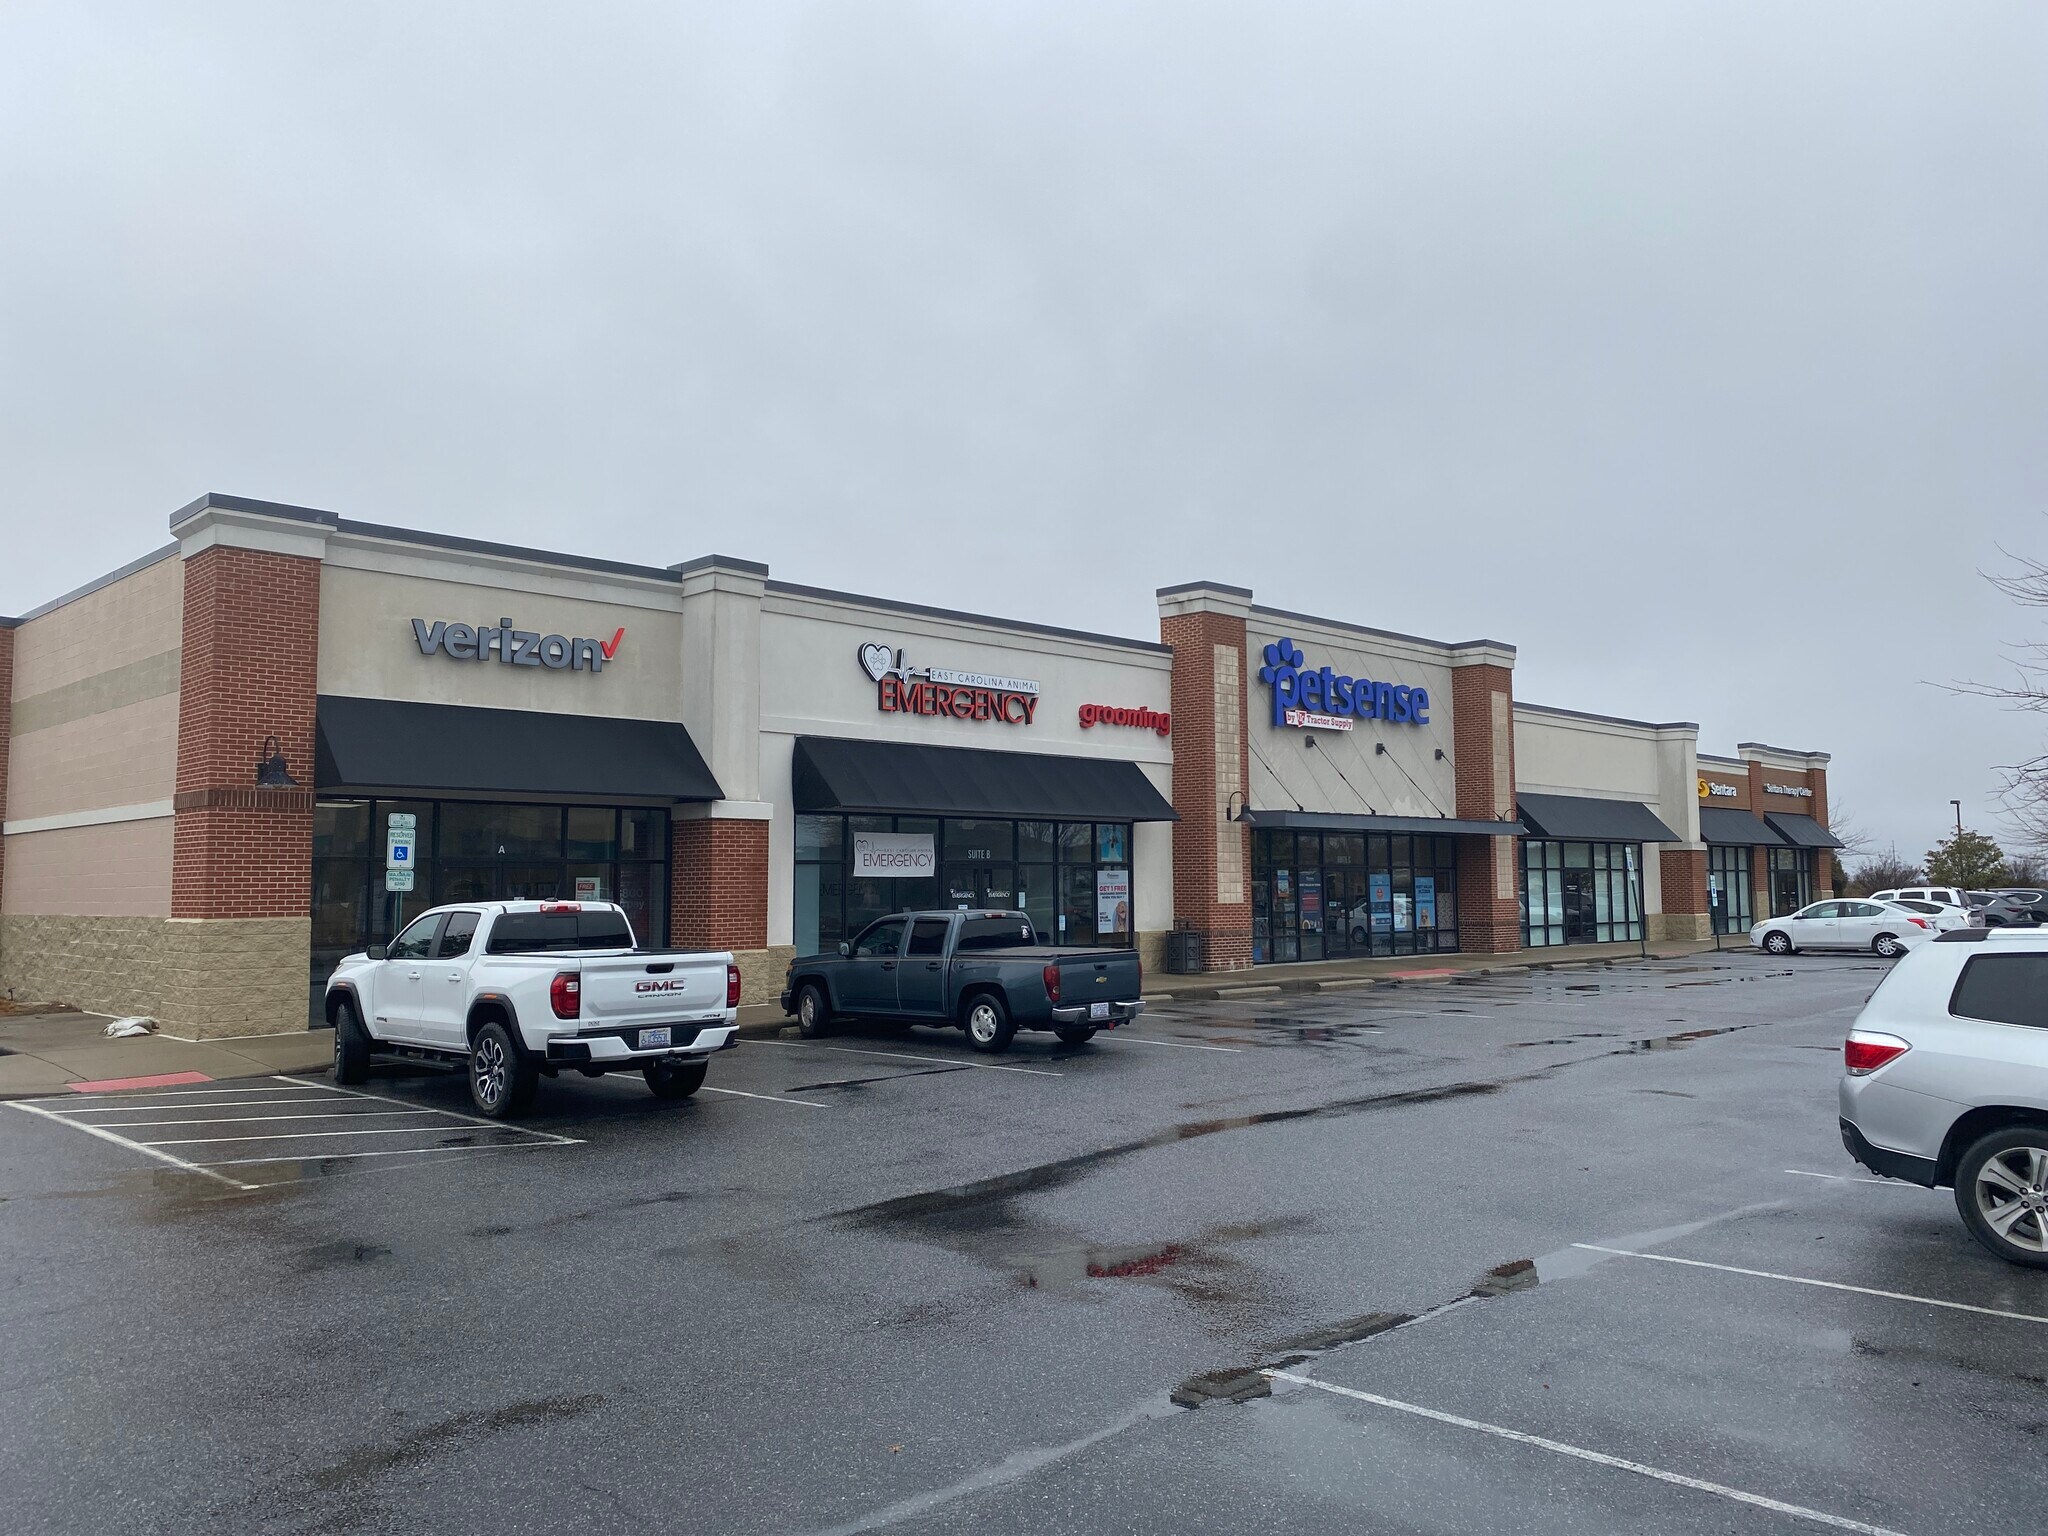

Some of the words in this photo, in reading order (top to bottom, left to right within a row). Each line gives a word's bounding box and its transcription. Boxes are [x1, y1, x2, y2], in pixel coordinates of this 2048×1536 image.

[411, 617, 602, 672] verizon
[932, 670, 954, 680] EAST
[958, 674, 1004, 687] CAROLINA
[1007, 681, 1039, 692] ANIMAL
[878, 680, 1039, 725] EMERGENCY
[1272, 666, 1430, 727] petsense
[1079, 704, 1171, 736] grooming
[1287, 713, 1295, 723] by
[1307, 715, 1330, 725] Tractor
[1331, 718, 1352, 729] Supply
[1710, 783, 1737, 797] Sentara
[498, 846, 505, 854] A
[968, 850, 985, 859] SUITE
[987, 850, 991, 859] B
[863, 854, 933, 867] EMERGENCY
[635, 980, 684, 992] GMC
